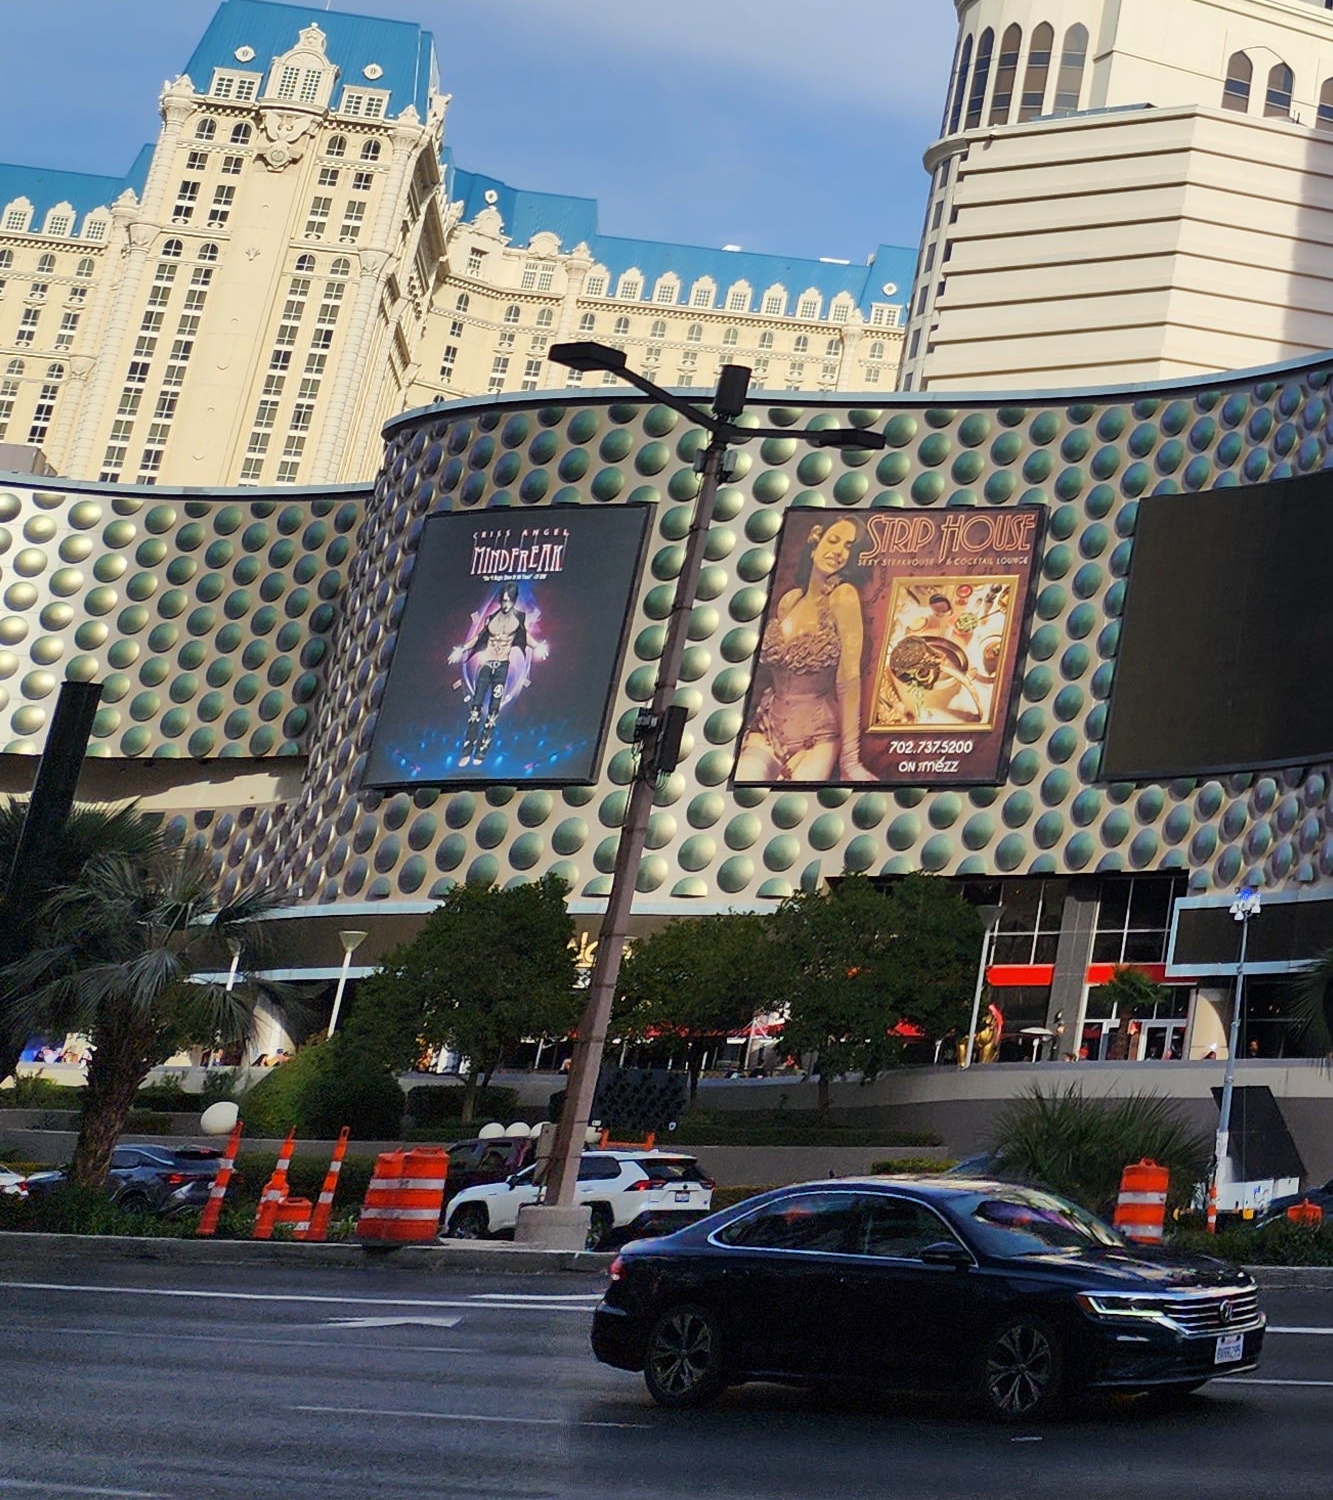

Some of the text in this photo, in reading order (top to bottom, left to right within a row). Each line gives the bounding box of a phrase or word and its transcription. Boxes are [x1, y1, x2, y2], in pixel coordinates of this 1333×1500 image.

[859, 514, 1036, 563] STRIP HOUSE
[470, 544, 563, 575] MINDFREAK
[857, 558, 879, 567] SEXY
[881, 558, 934, 567] STEAKHOUSE
[954, 557, 993, 566] COCKTAIL
[996, 556, 1029, 565] LOUNGE
[888, 740, 974, 754] 702.737.5200
[898, 761, 915, 773] ON
